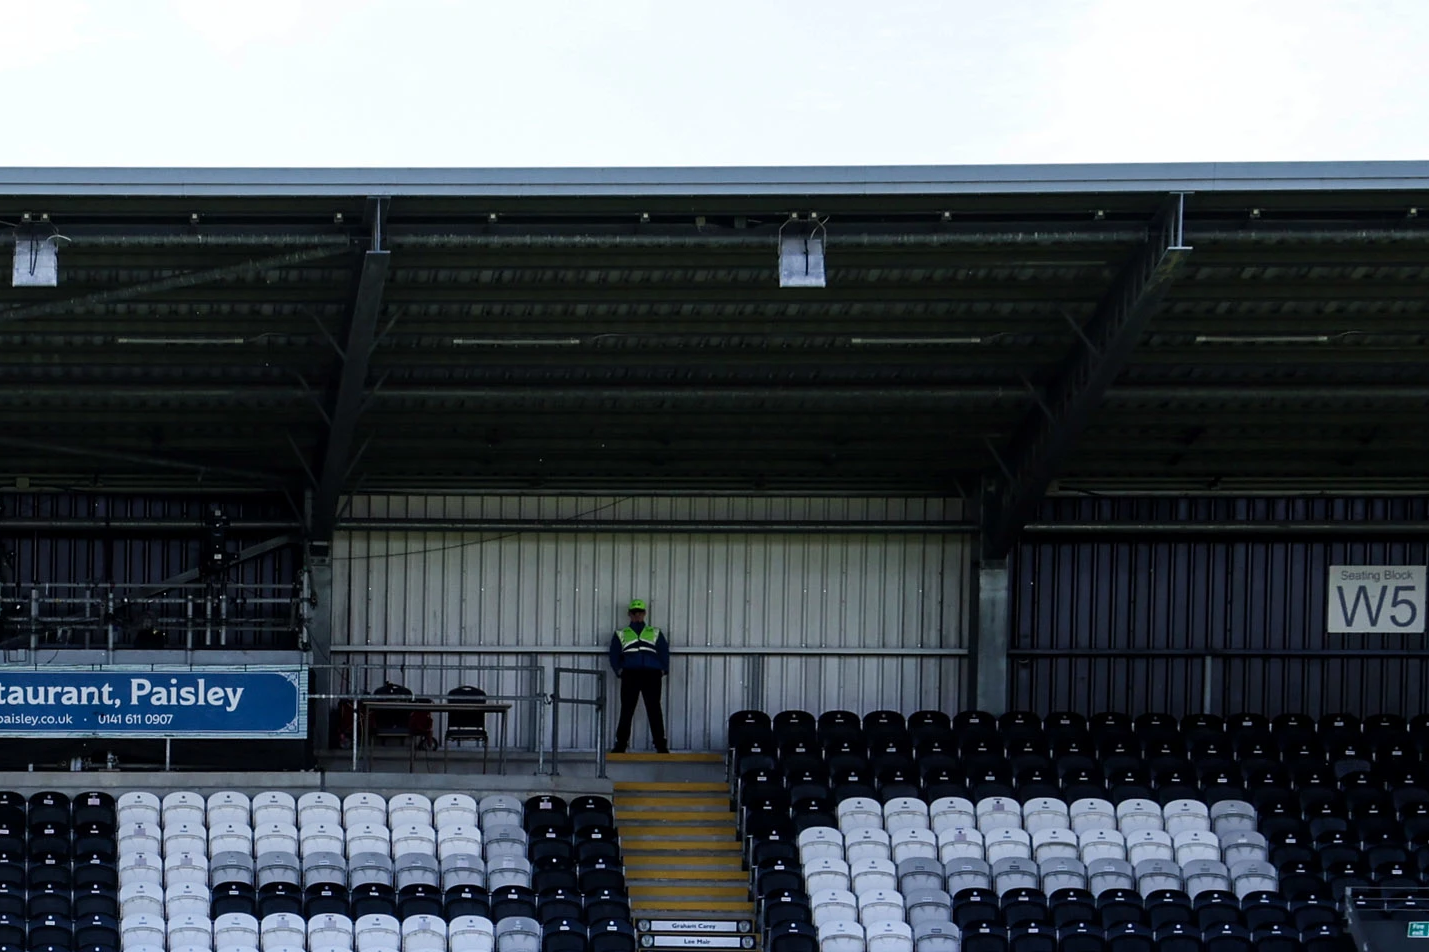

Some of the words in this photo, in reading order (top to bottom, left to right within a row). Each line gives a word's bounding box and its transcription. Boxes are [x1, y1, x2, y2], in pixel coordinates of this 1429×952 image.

[1341, 570, 1381, 582] Seating
[1384, 570, 1413, 580] Block
[1337, 585, 1417, 627] W5
[130, 676, 244, 712] Paisley
[98, 714, 121, 725] 0141
[125, 714, 141, 725] 611
[145, 714, 173, 725] 0907
